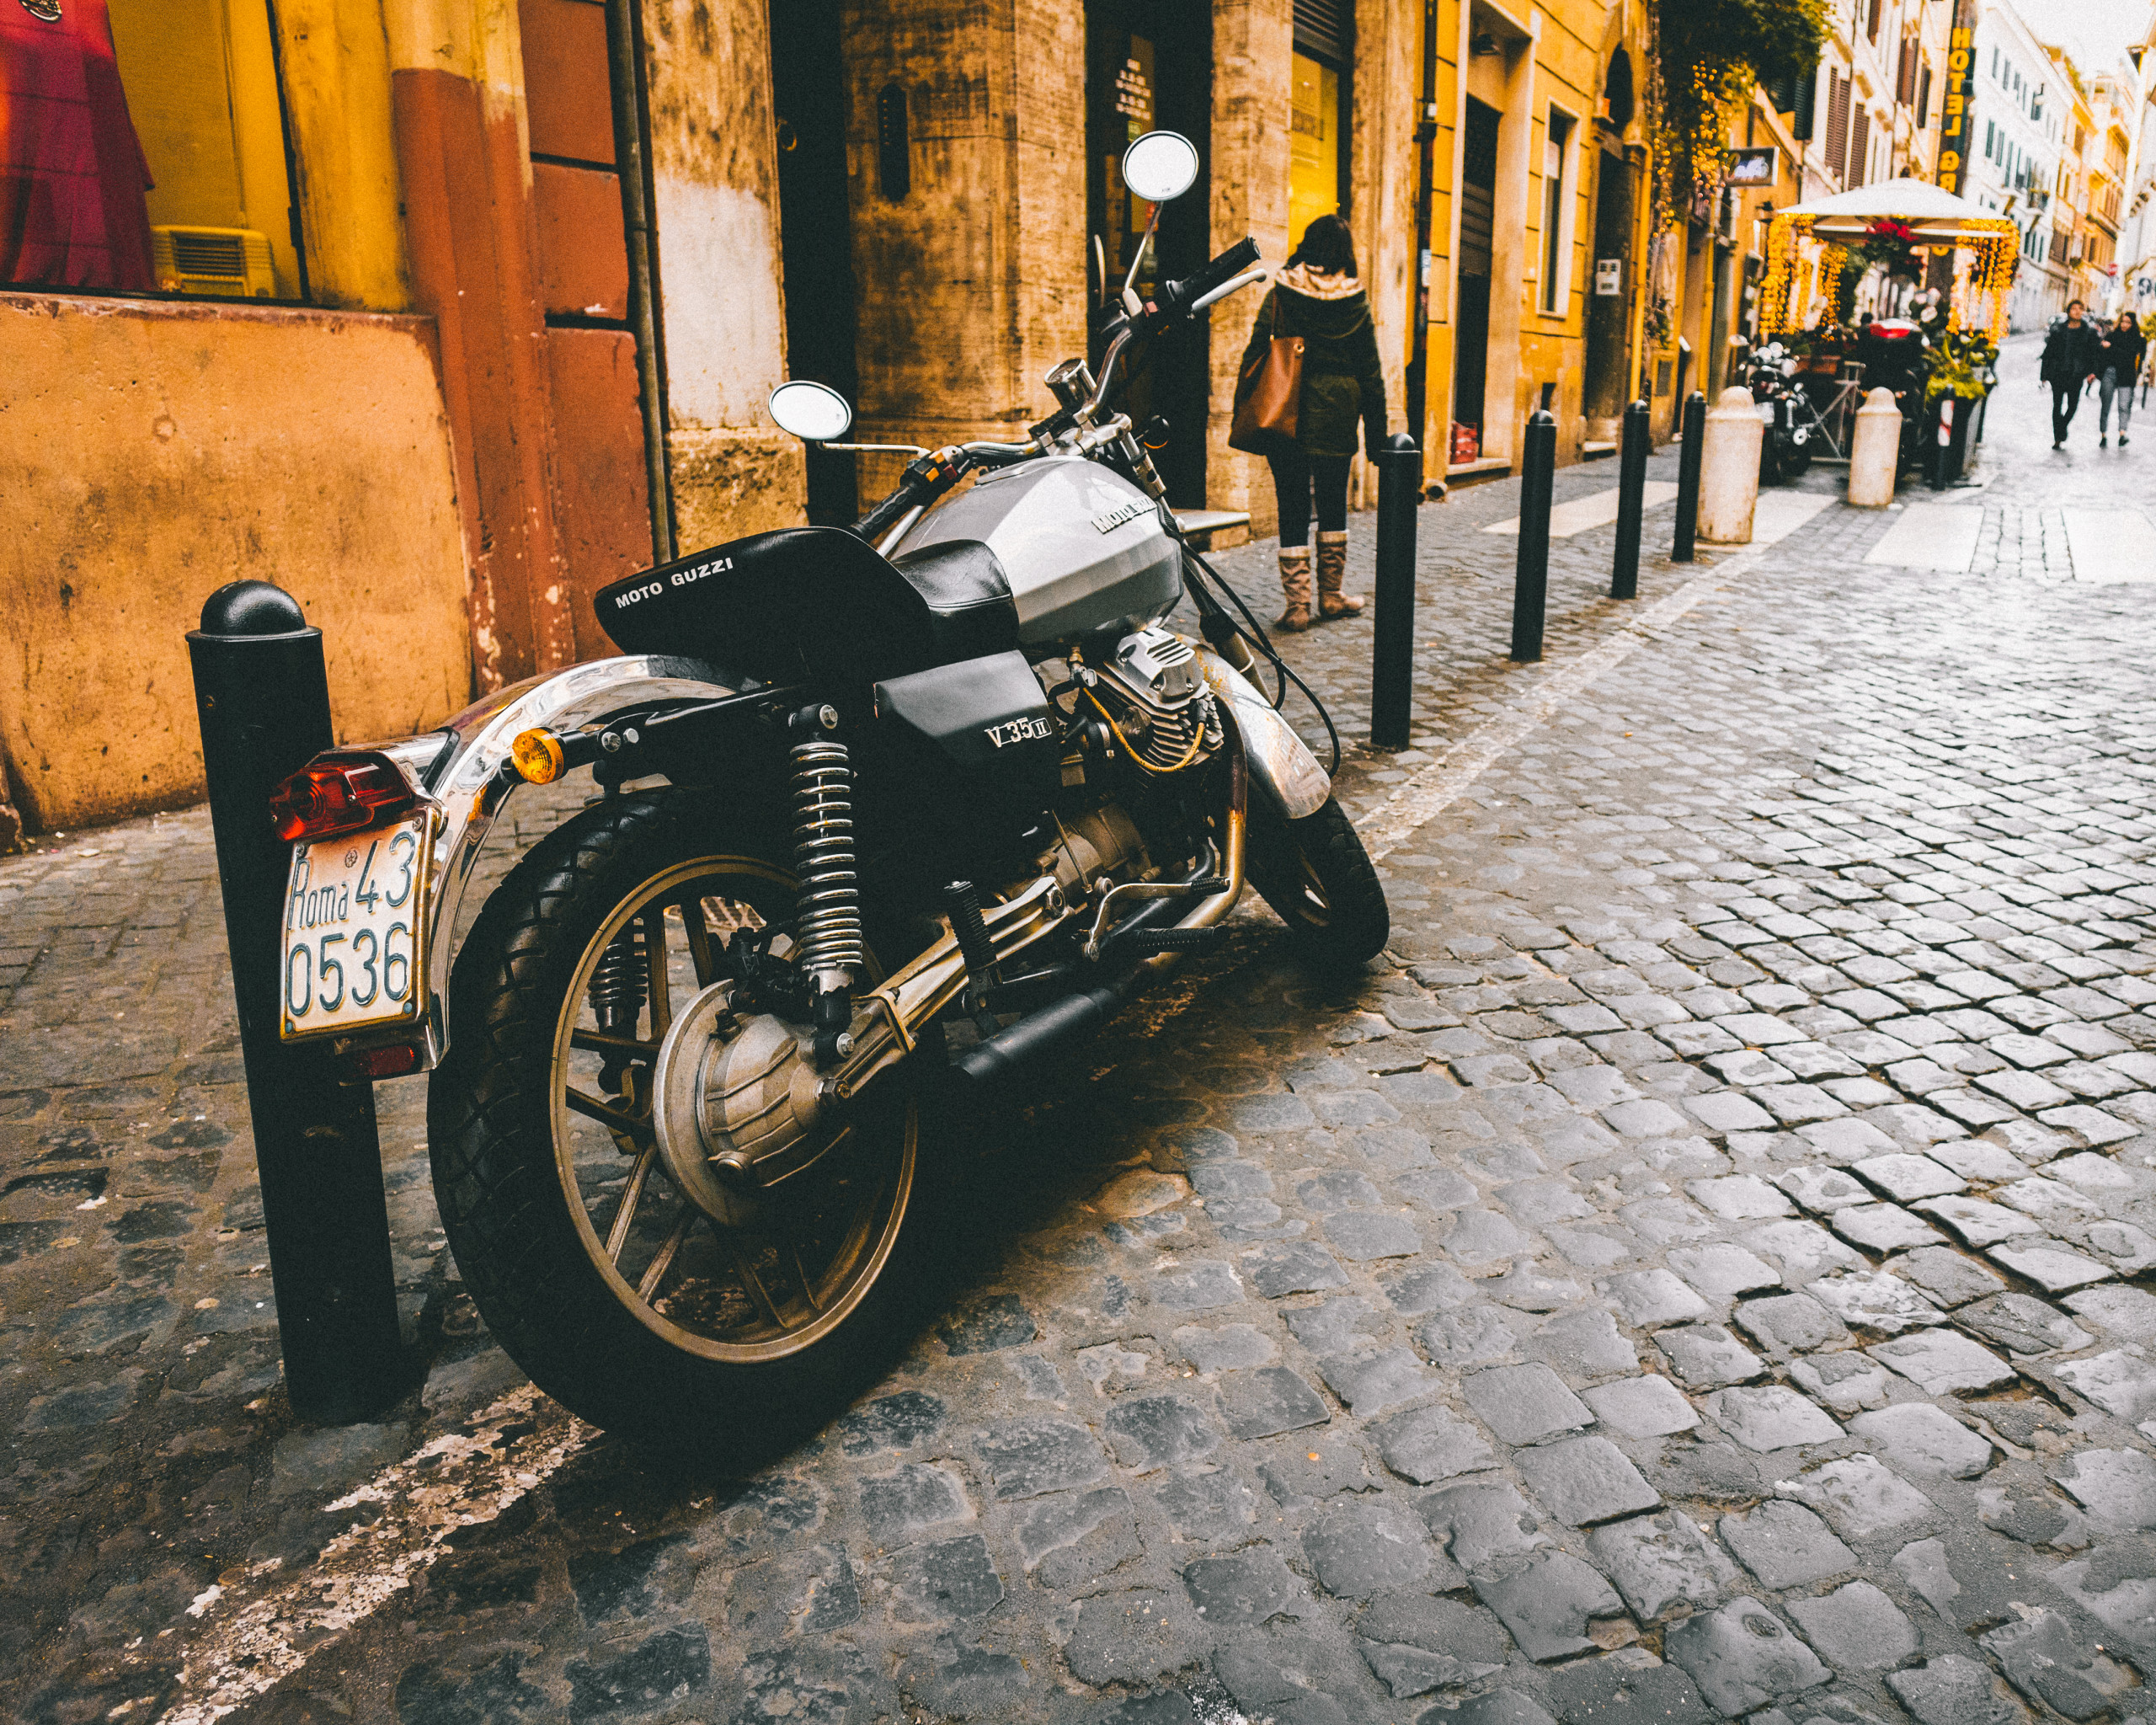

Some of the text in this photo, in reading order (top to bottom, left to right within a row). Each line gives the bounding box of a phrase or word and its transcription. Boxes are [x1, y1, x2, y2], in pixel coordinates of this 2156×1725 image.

[1091, 504, 1135, 535] MOTO
[615, 557, 734, 608] MOTO GUZZI
[984, 726, 1002, 748] V
[1005, 717, 1033, 743] 35
[287, 830, 416, 930] Roma 43
[287, 921, 411, 1017] 0536
